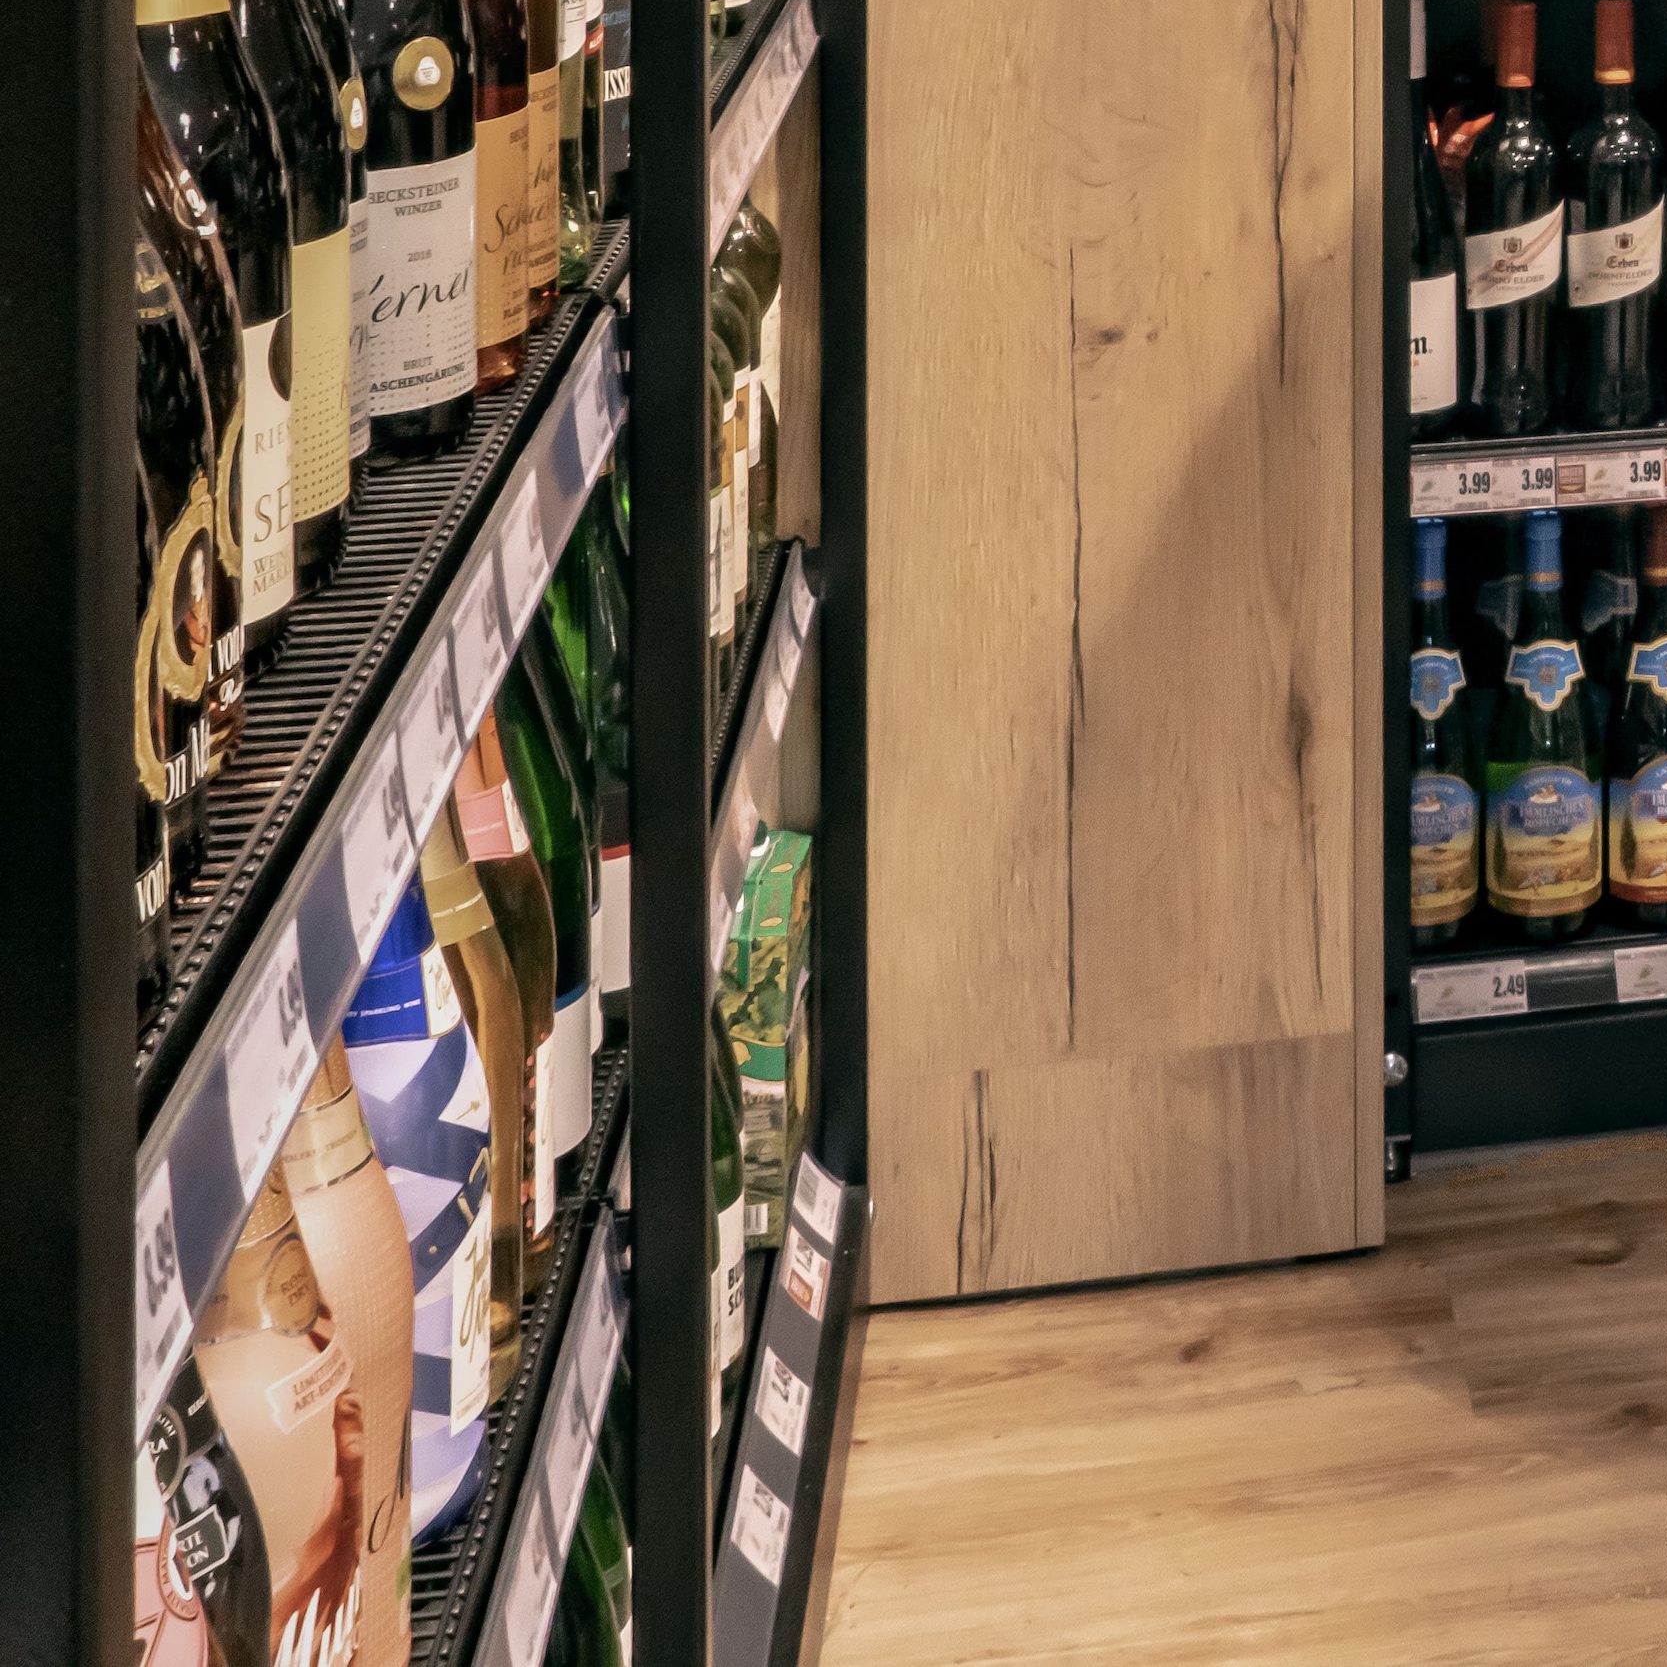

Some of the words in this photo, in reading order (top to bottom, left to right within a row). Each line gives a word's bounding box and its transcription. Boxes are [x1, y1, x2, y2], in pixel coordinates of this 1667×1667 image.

[368, 177, 459, 204] BECKSTEINER
[395, 199, 442, 216] WINZER
[1494, 260, 1529, 273] Erben
[1606, 255, 1639, 269] Erben
[371, 270, 468, 323] erner
[403, 357, 433, 371] BRUT
[1521, 468, 1553, 490] 3.99
[1630, 460, 1661, 482] 3.99
[1459, 471, 1490, 494] 3.99
[1493, 976, 1525, 997] 2.49
